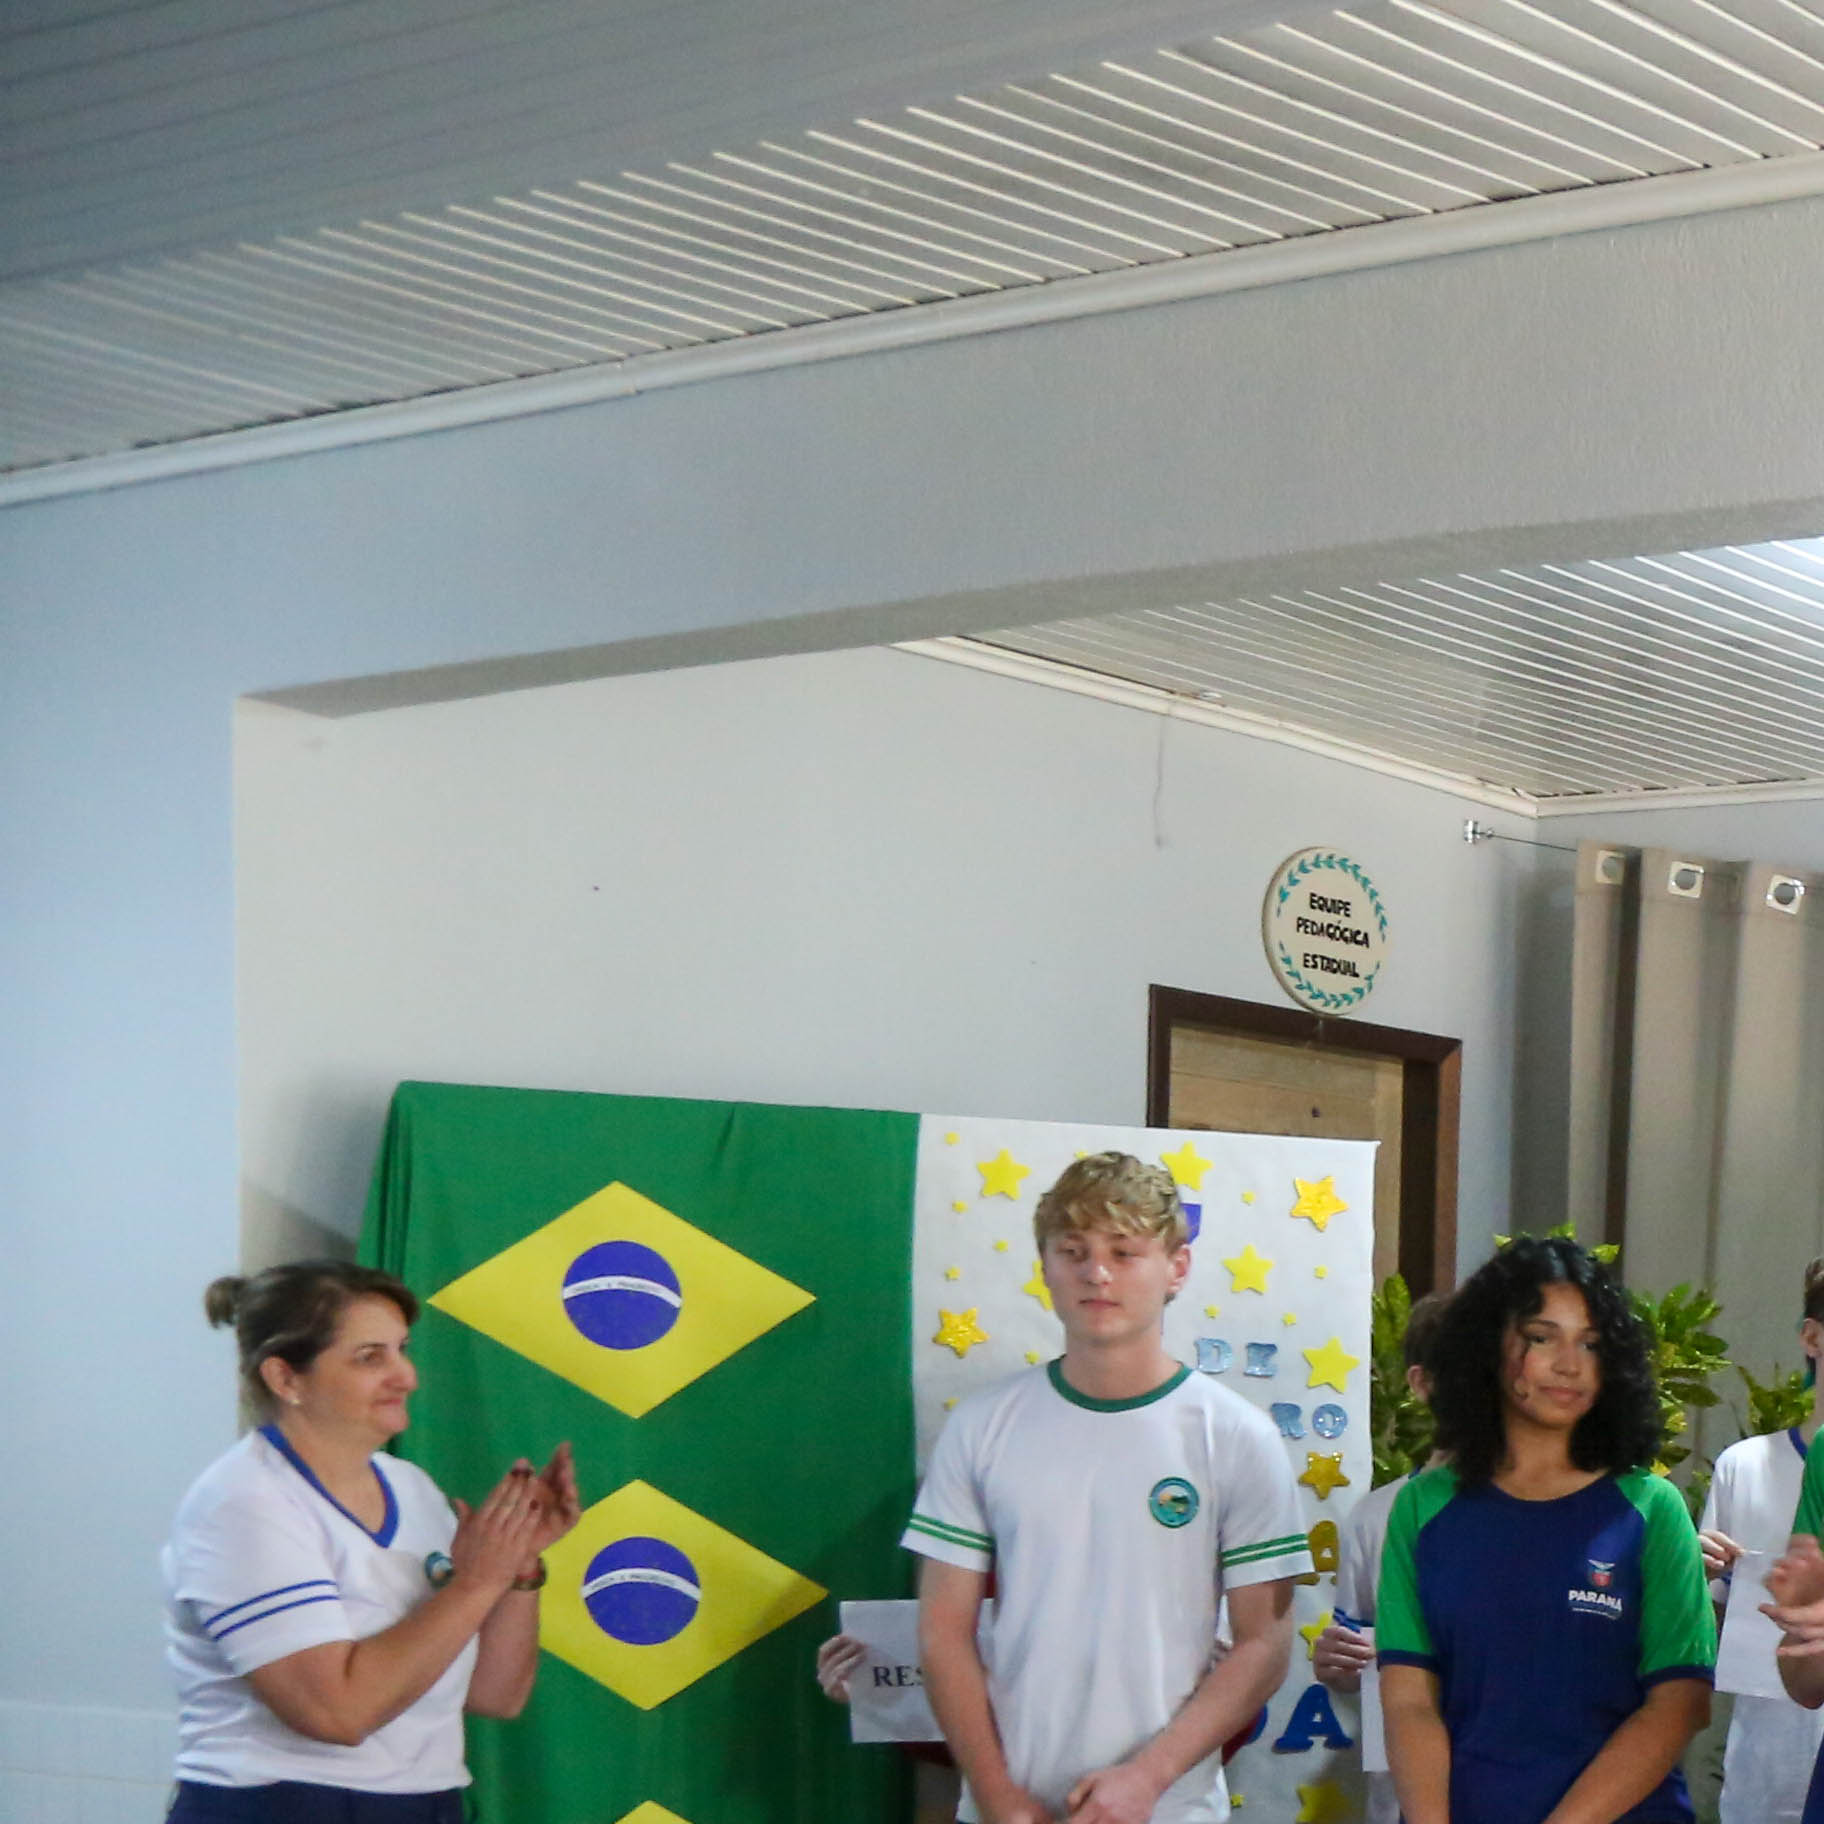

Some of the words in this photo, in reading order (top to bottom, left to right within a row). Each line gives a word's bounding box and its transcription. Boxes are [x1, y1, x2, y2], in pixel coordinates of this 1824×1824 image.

[1309, 892, 1351, 918] EQUIPE
[1296, 916, 1370, 949] PEDAGÓGICA
[1302, 952, 1360, 978] ESTADUAL
[1193, 1337, 1279, 1377] DE
[1270, 1401, 1349, 1440] RO
